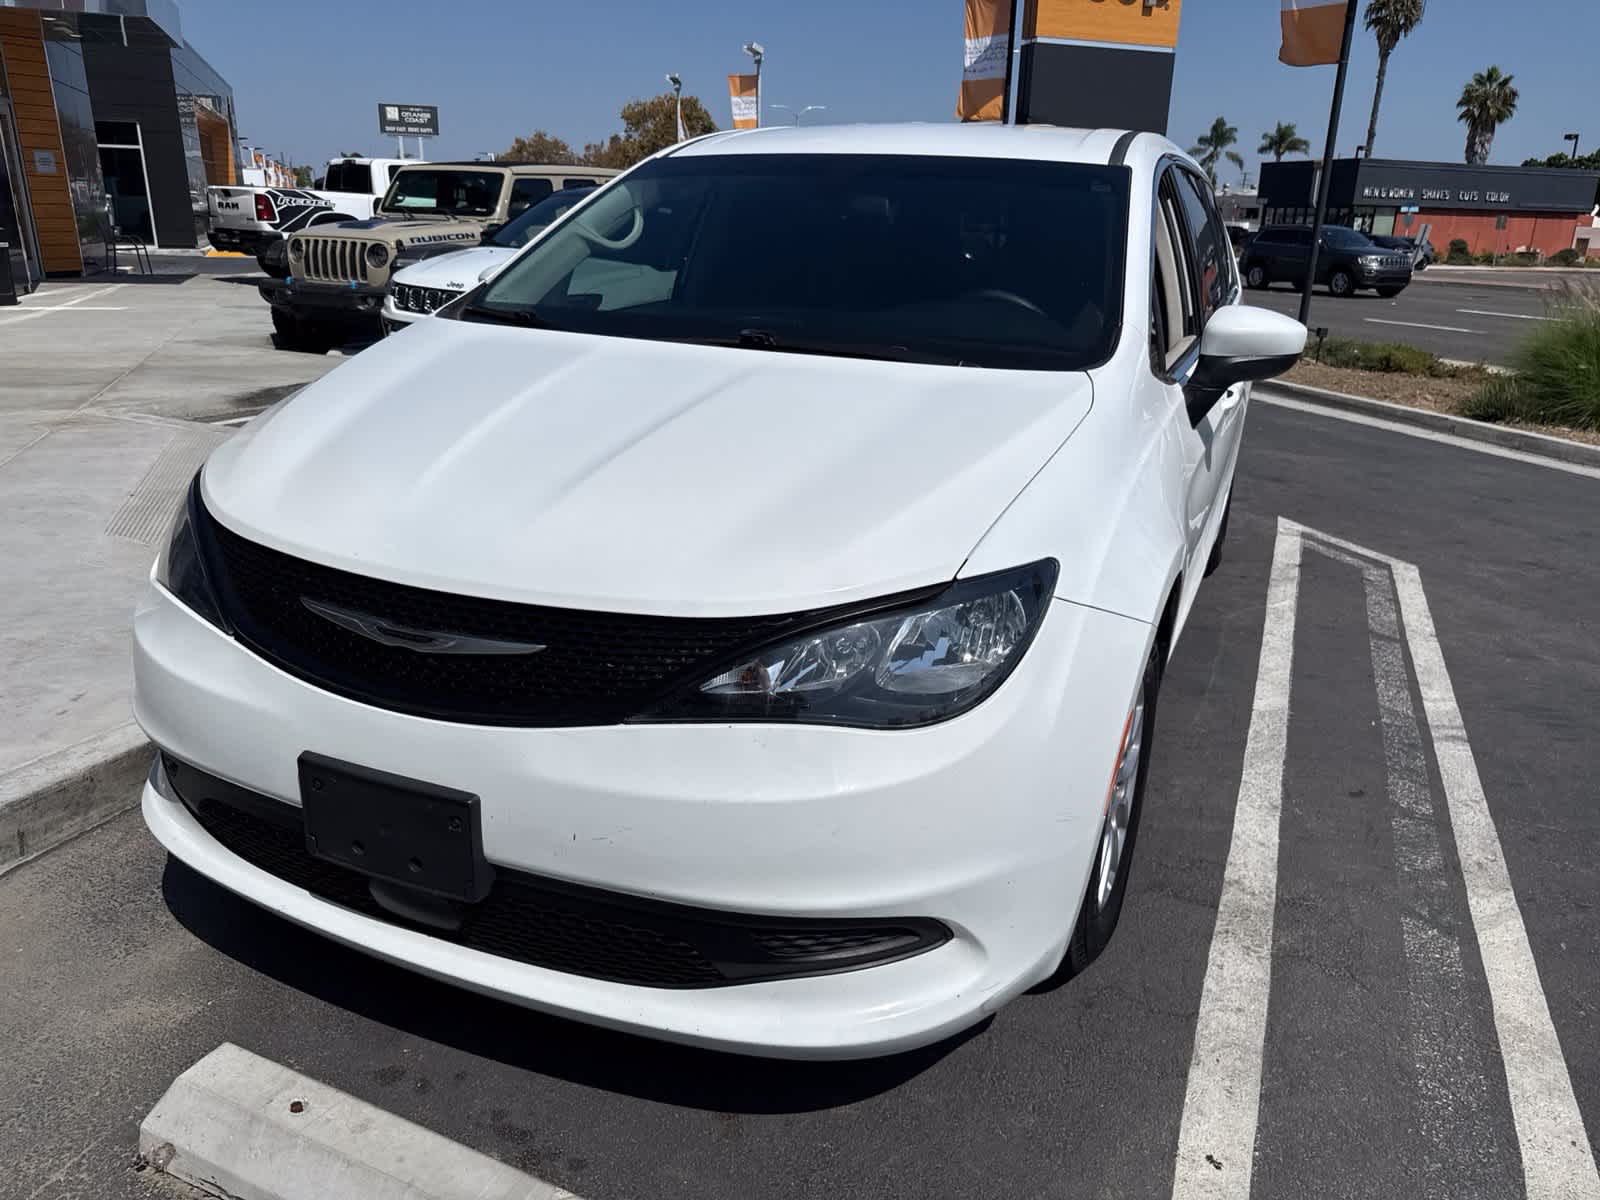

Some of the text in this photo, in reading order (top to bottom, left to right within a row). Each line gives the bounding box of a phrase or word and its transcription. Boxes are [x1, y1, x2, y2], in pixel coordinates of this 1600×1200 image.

[1363, 187, 1379, 198] MEN
[1389, 188, 1415, 199] WOMEN
[1422, 189, 1450, 200] SHAVES
[1459, 190, 1479, 201] CUTS
[1486, 191, 1510, 203] COLOR
[217, 201, 240, 210] RAM
[277, 196, 336, 208] REBEL
[409, 232, 476, 244] RUBICON
[446, 281, 465, 289] Jeep
